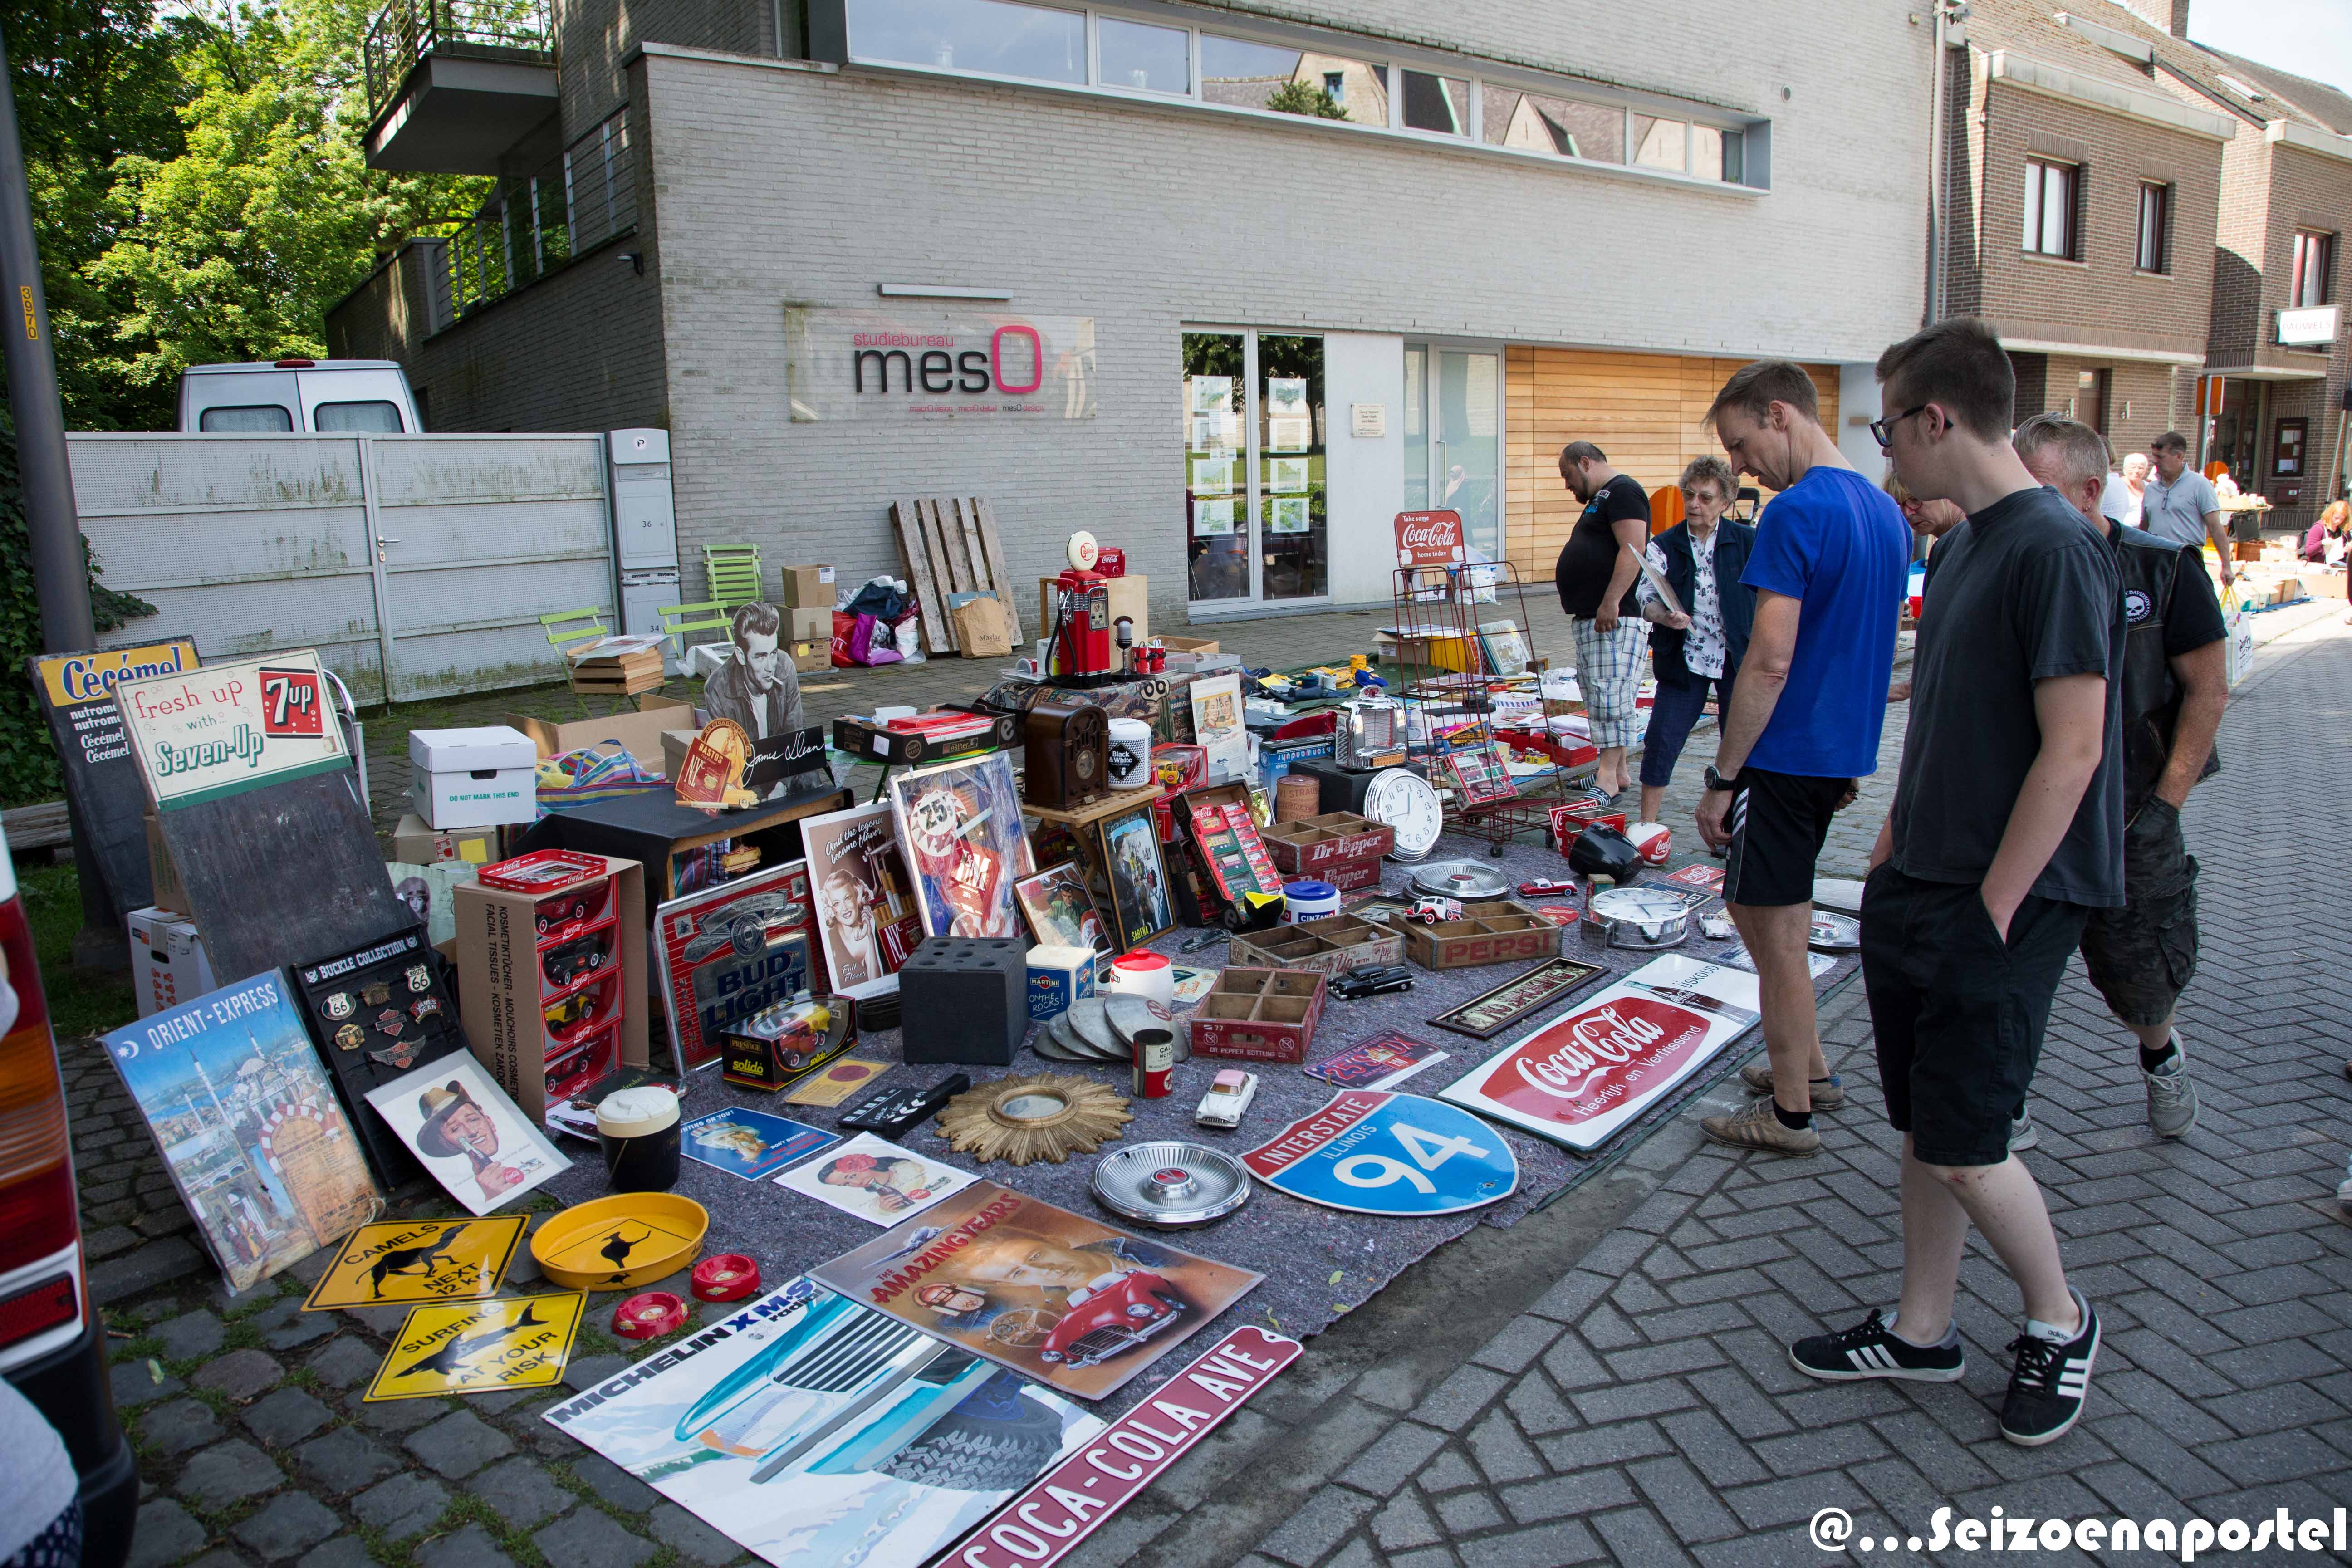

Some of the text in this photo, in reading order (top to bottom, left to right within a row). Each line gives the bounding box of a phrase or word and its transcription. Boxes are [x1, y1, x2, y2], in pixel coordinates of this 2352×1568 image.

[22, 287, 37, 338] 3970
[2282, 319, 2331, 331] PAUWELS
[853, 331, 954, 347] studiebureau
[1023, 404, 1044, 413] design
[1402, 522, 1455, 549] Coca-Cola
[1102, 554, 1118, 563] Coca-Cola
[980, 633, 1001, 642] Mayfair
[62, 646, 183, 701] Cécémel
[134, 681, 243, 719] fresh up
[80, 727, 126, 749] Cécémel
[85, 742, 131, 764] Cécémel
[156, 724, 264, 777] Seven-Up
[698, 743, 724, 764] BASTOS
[742, 744, 784, 788] James
[785, 731, 825, 760] Dean
[1388, 791, 1395, 800] 11
[1395, 784, 1403, 793] 12
[1408, 784, 1413, 792] 1
[1417, 789, 1423, 799] 2
[1385, 804, 1393, 813] 10
[1424, 802, 1431, 810] 3
[1426, 814, 1433, 823] 4
[825, 814, 884, 856] And the legend
[1405, 834, 1411, 843] 7
[1415, 833, 1421, 842] 6
[1423, 827, 1430, 835] 5
[831, 840, 858, 864] became
[1311, 835, 1382, 861] Dr Pepper
[503, 860, 520, 872] Coca-Cola
[1680, 866, 1715, 885] Coca-Cola
[568, 872, 585, 884] Coca-Cola
[1323, 868, 1369, 889] Pepper
[564, 923, 583, 936] Coca-Cola
[1132, 926, 1149, 942] SABENA
[500, 906, 512, 991] KOSMETIKTÜCHER
[1445, 933, 1551, 963] PEPSI
[318, 939, 407, 980] BUCKLE COLLECTION
[489, 941, 499, 984] TISSUES
[842, 962, 857, 974] Full
[1335, 952, 1354, 973] Up
[409, 967, 425, 976] ROUTE
[572, 974, 589, 988] Coca-Cola
[716, 950, 792, 998] BUD
[844, 971, 867, 983] Flavor
[411, 976, 428, 990] 66
[1030, 977, 1059, 988] MARTINI
[416, 999, 436, 1009] JAMES
[707, 970, 807, 1032] LIGHT
[1033, 992, 1064, 1012] ROCKS!
[1471, 969, 1575, 1021] NO SMOKING
[1670, 990, 1696, 1004] Coca-Cola
[333, 1001, 348, 1014] 66
[418, 1005, 436, 1015] DEAN
[491, 992, 504, 1049] KOSMETIEK
[504, 998, 516, 1053] MOUCHOIRS
[574, 1026, 592, 1040] Coca-Cola
[731, 1038, 761, 1052] PRESTIGE
[1246, 1049, 1275, 1057] BOTTLING
[1515, 1004, 1665, 1098] Coca-Cola
[732, 1059, 764, 1073] solido
[810, 1051, 827, 1065] solido
[1324, 1054, 1381, 1081] 25'S
[495, 1052, 505, 1089] ZAKDO
[1572, 1024, 1702, 1117] Heerlijk en Verfrissend
[572, 1080, 589, 1094] Coca-Cola
[705, 1109, 735, 1124] ON YOU!
[1258, 1096, 1374, 1166] INTERSTATE
[770, 1140, 785, 1150] DON'T
[1319, 1124, 1377, 1161] ILLINOIS
[1333, 1122, 1490, 1194] 94
[911, 1190, 926, 1198] Coca-Cola
[343, 1224, 441, 1265] CAMELS
[870, 1193, 1022, 1303] AMAZING YEARS
[423, 1262, 480, 1291] NEXT
[436, 1269, 497, 1297] 12 km
[876, 1268, 896, 1281] THE
[768, 1288, 825, 1322] radial
[401, 1303, 505, 1354] SURFING
[457, 1331, 559, 1385] AT YOUR
[496, 1351, 555, 1382] RISK
[549, 1326, 732, 1425] MICHELIN
[726, 1312, 763, 1333] X
[962, 1343, 1276, 1568] COCA-COLA AVE
